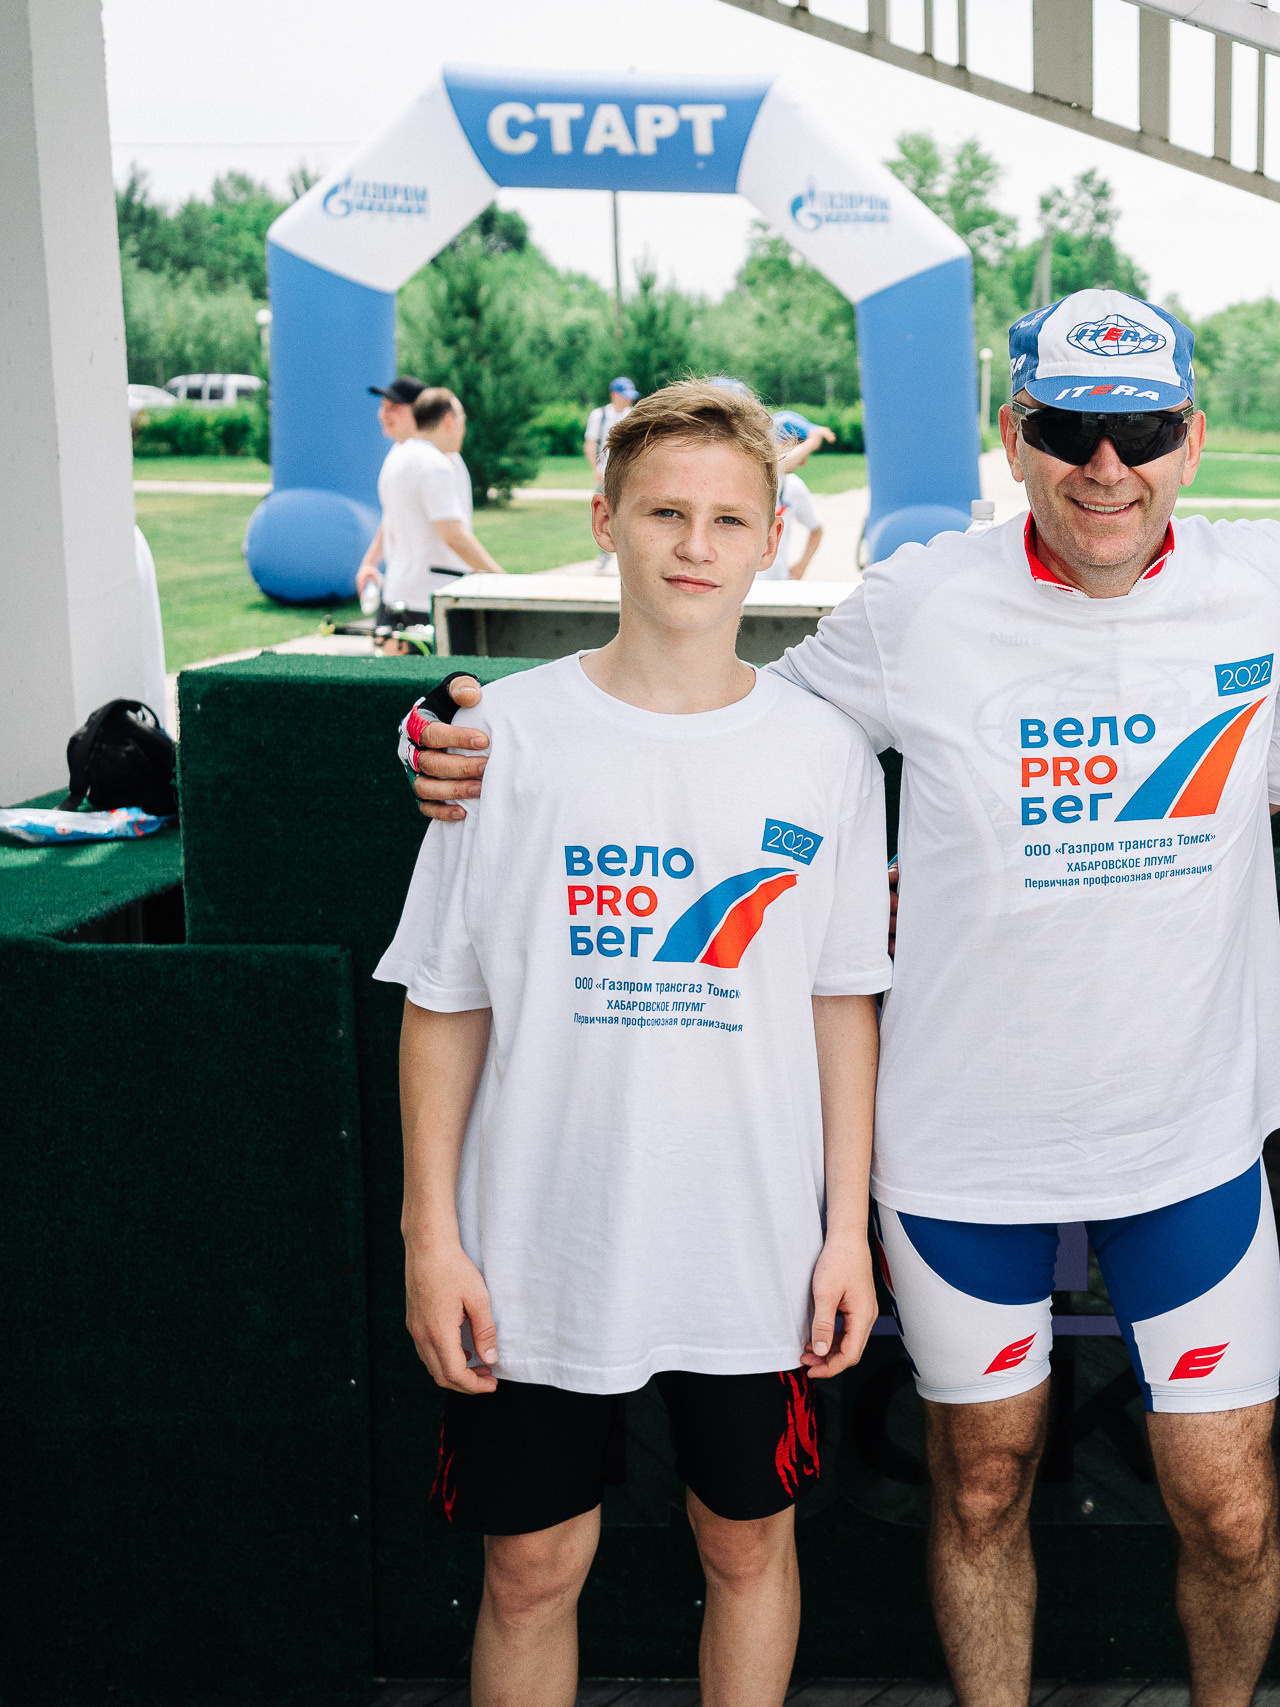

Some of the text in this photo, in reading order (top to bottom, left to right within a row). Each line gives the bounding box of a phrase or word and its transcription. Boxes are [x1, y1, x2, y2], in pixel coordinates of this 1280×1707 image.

[486, 101, 726, 156] СТАРТ
[1075, 327, 1159, 343] ITERA
[1054, 384, 1161, 401] ITERA
[1220, 660, 1271, 691] 2022
[1021, 755, 1118, 788] PRO
[765, 825, 814, 859] 2022
[1024, 833, 1216, 857] ООО «Газпром трансгаз Томск»
[1066, 854, 1178, 873] ХАБАРОВСКОЕ ЛПУМГ
[1024, 863, 1213, 889] Первичная профсоюзная организация
[567, 884, 658, 917] PRO
[575, 976, 741, 999] ООО «Газпром трансгаз Томск
[606, 999, 706, 1012] ХАБАРОВСКОЕ ЛПУМГ
[621, 1016, 678, 1028] профсоюзная
[680, 1017, 743, 1032] организация
